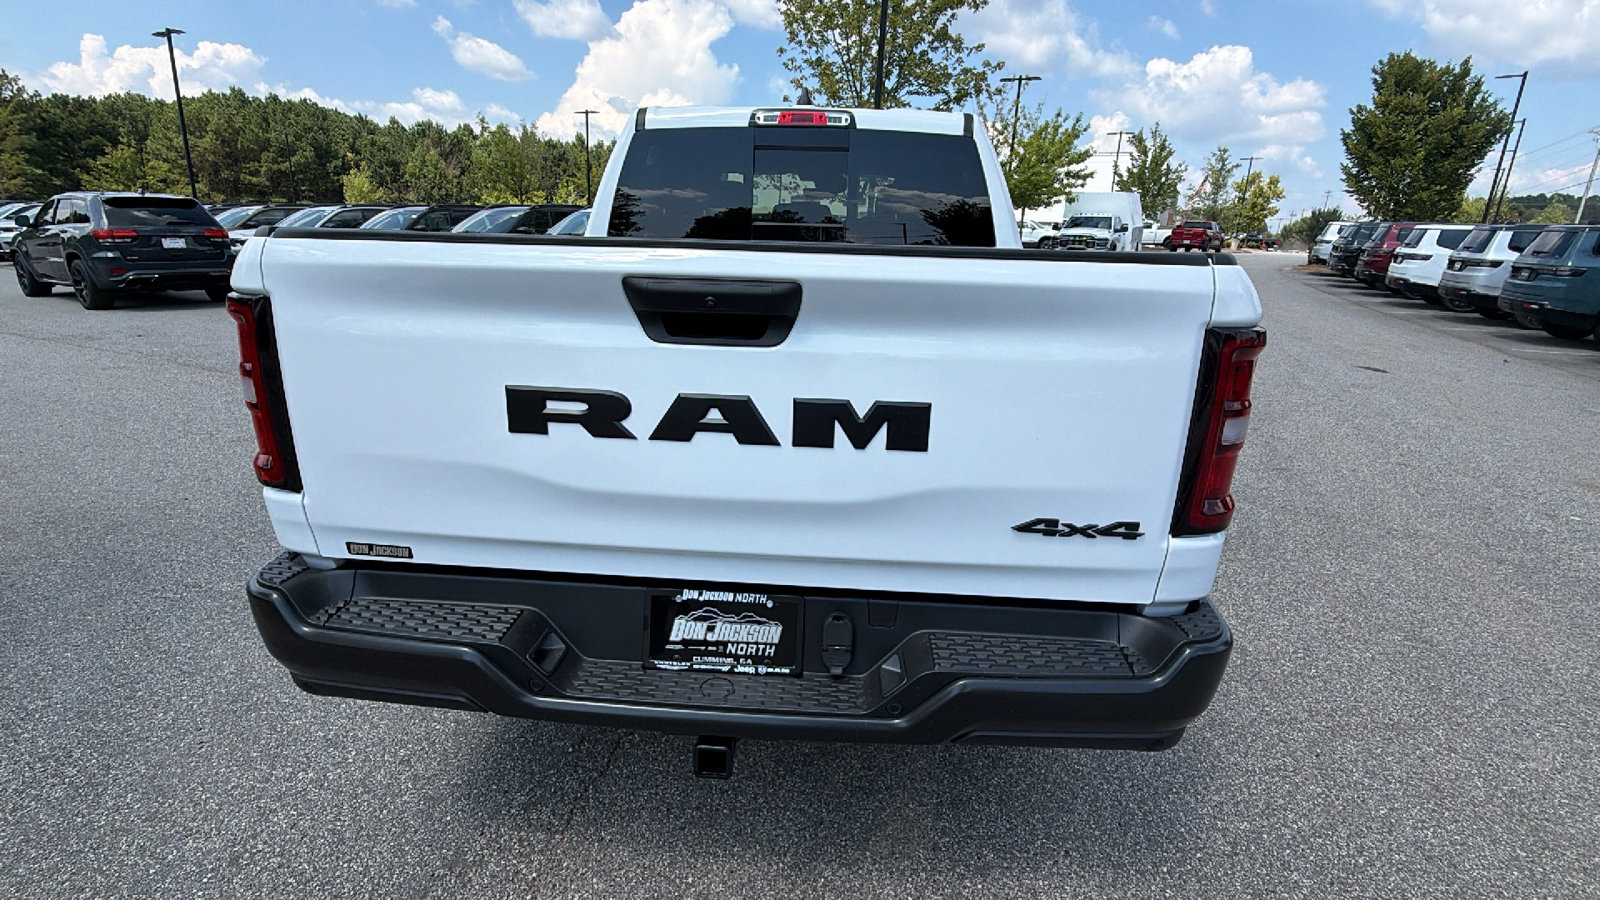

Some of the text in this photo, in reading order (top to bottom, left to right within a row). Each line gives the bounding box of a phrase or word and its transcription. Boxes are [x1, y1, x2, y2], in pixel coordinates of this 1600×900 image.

[505, 384, 933, 453] RAM
[1010, 517, 1145, 540] 4x4
[735, 592, 768, 604] NORTH
[726, 643, 776, 657] NORTH
[734, 665, 756, 674] Jeep
